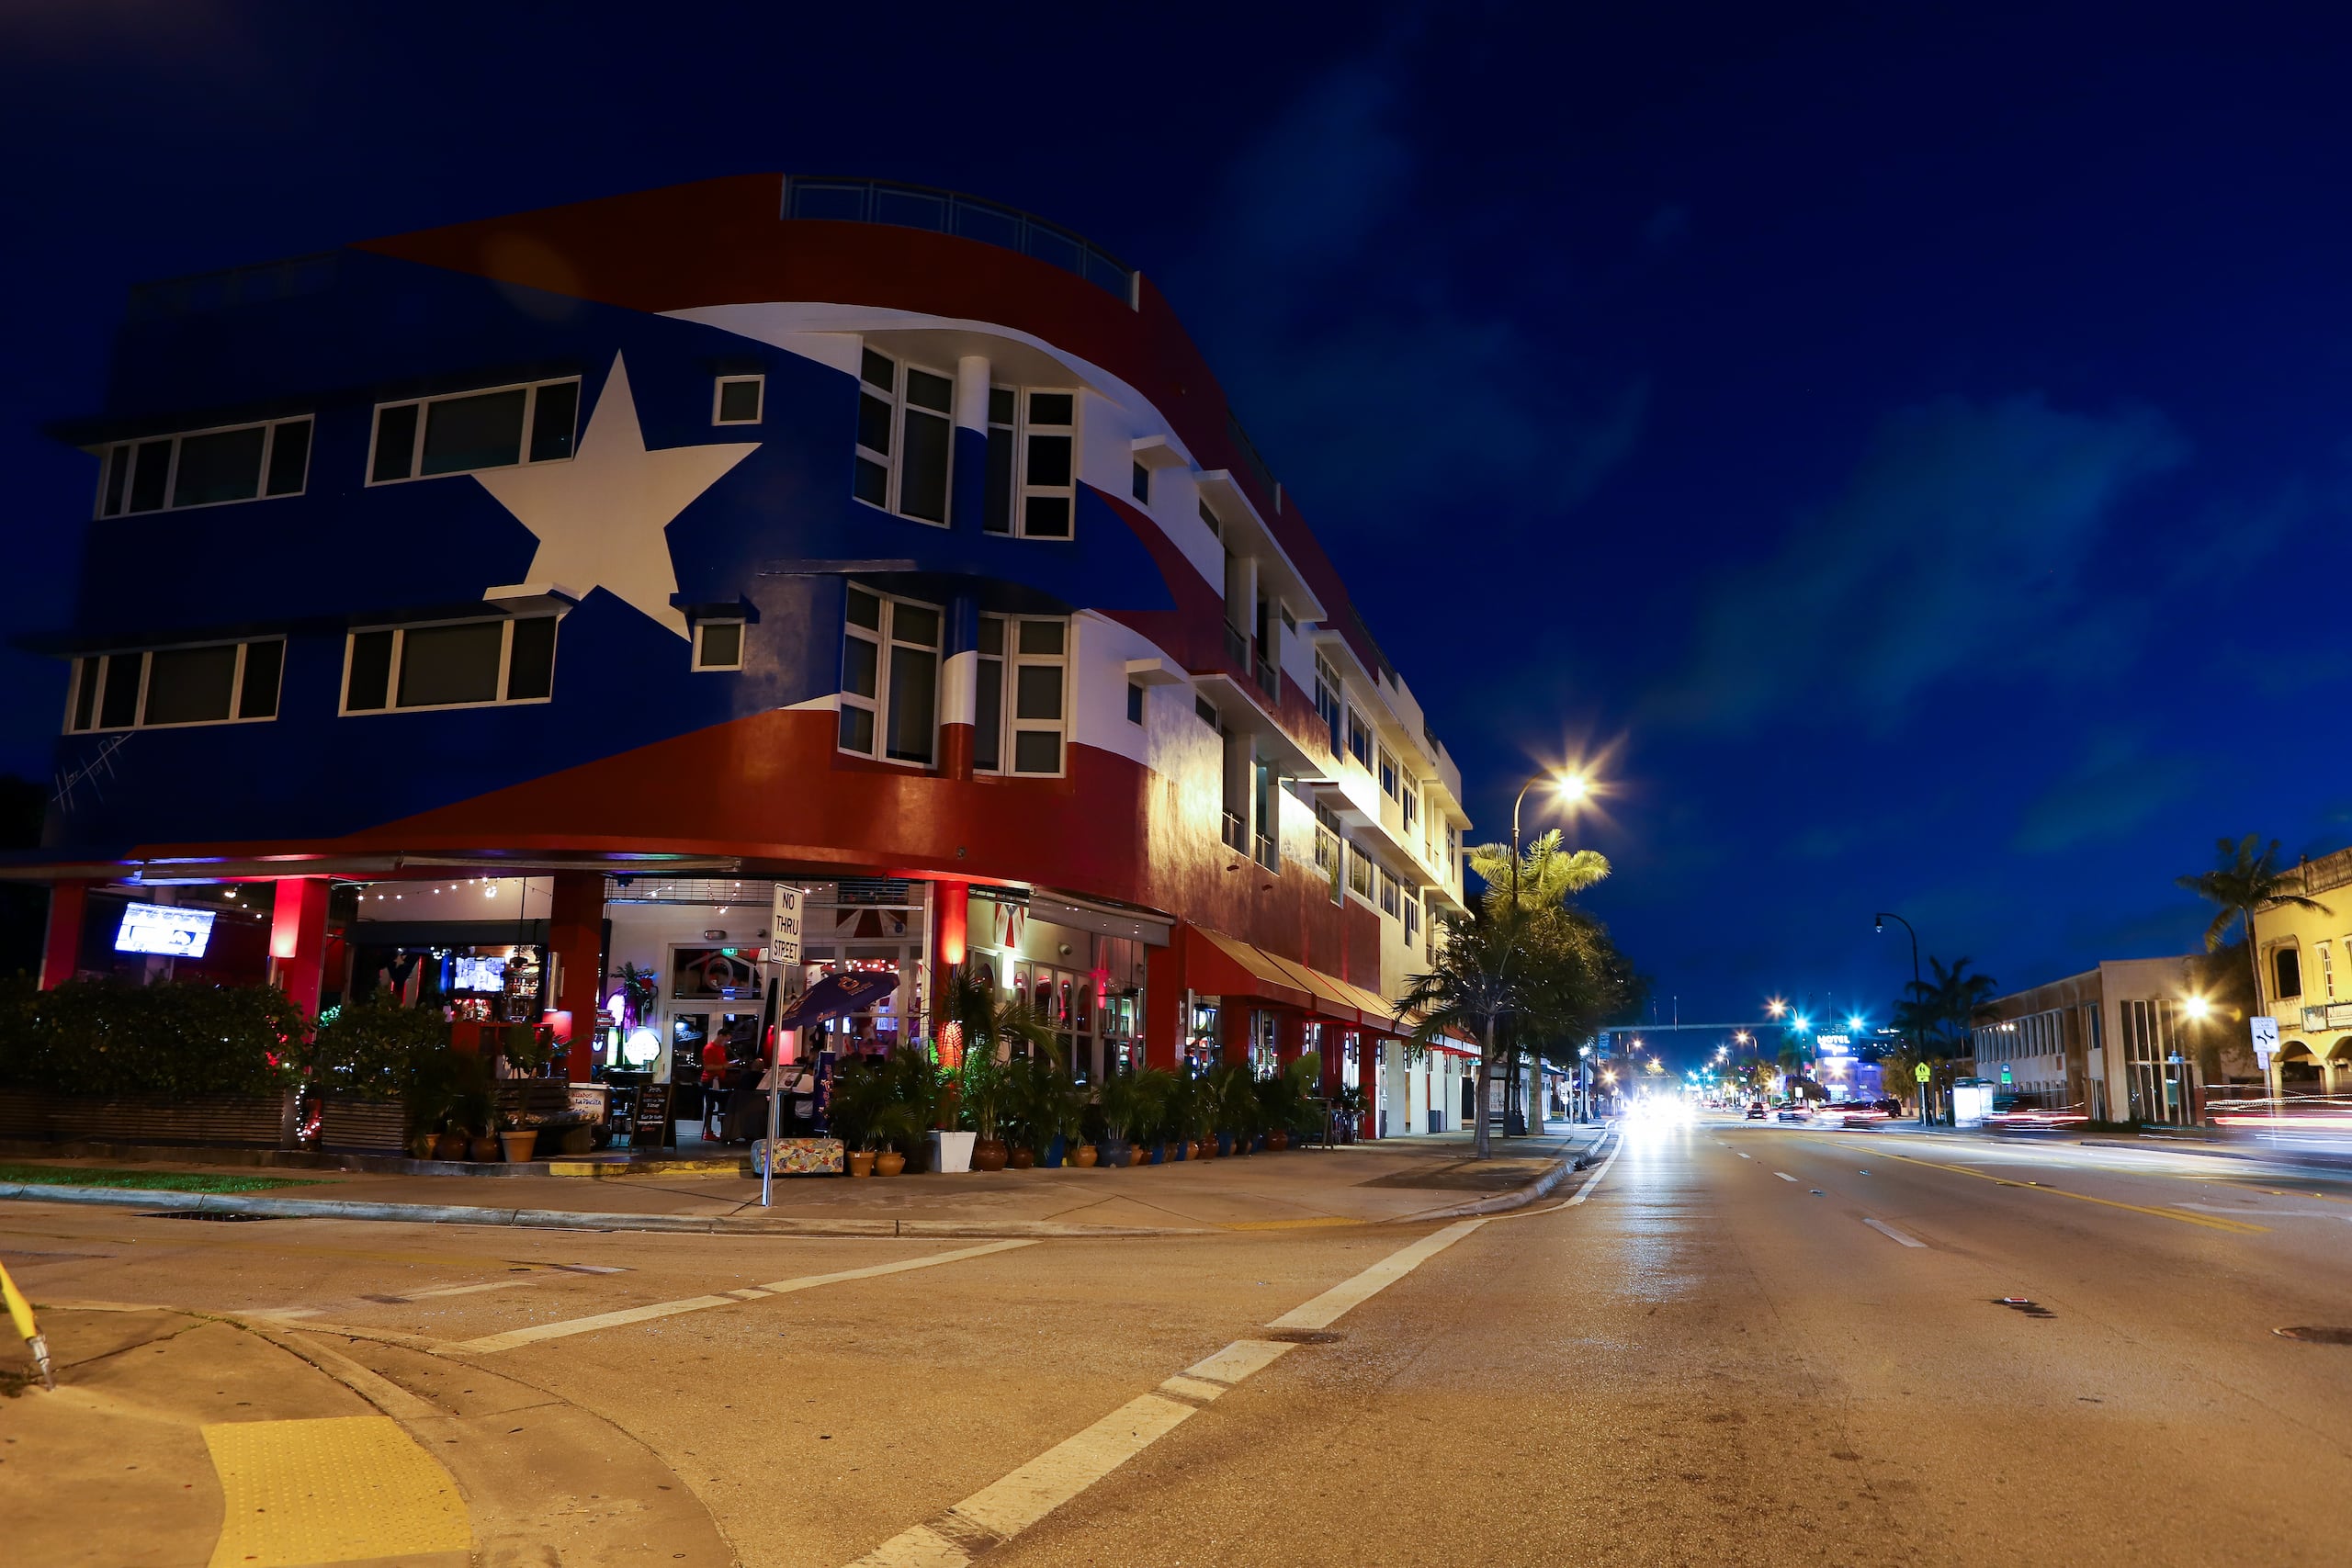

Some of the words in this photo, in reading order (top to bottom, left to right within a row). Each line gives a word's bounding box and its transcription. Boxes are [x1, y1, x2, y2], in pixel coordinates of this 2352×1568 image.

[782, 892, 795, 910] NO
[776, 915, 799, 935] THRU
[774, 939, 798, 959] STREET
[1817, 1035, 1850, 1043] MOTEL
